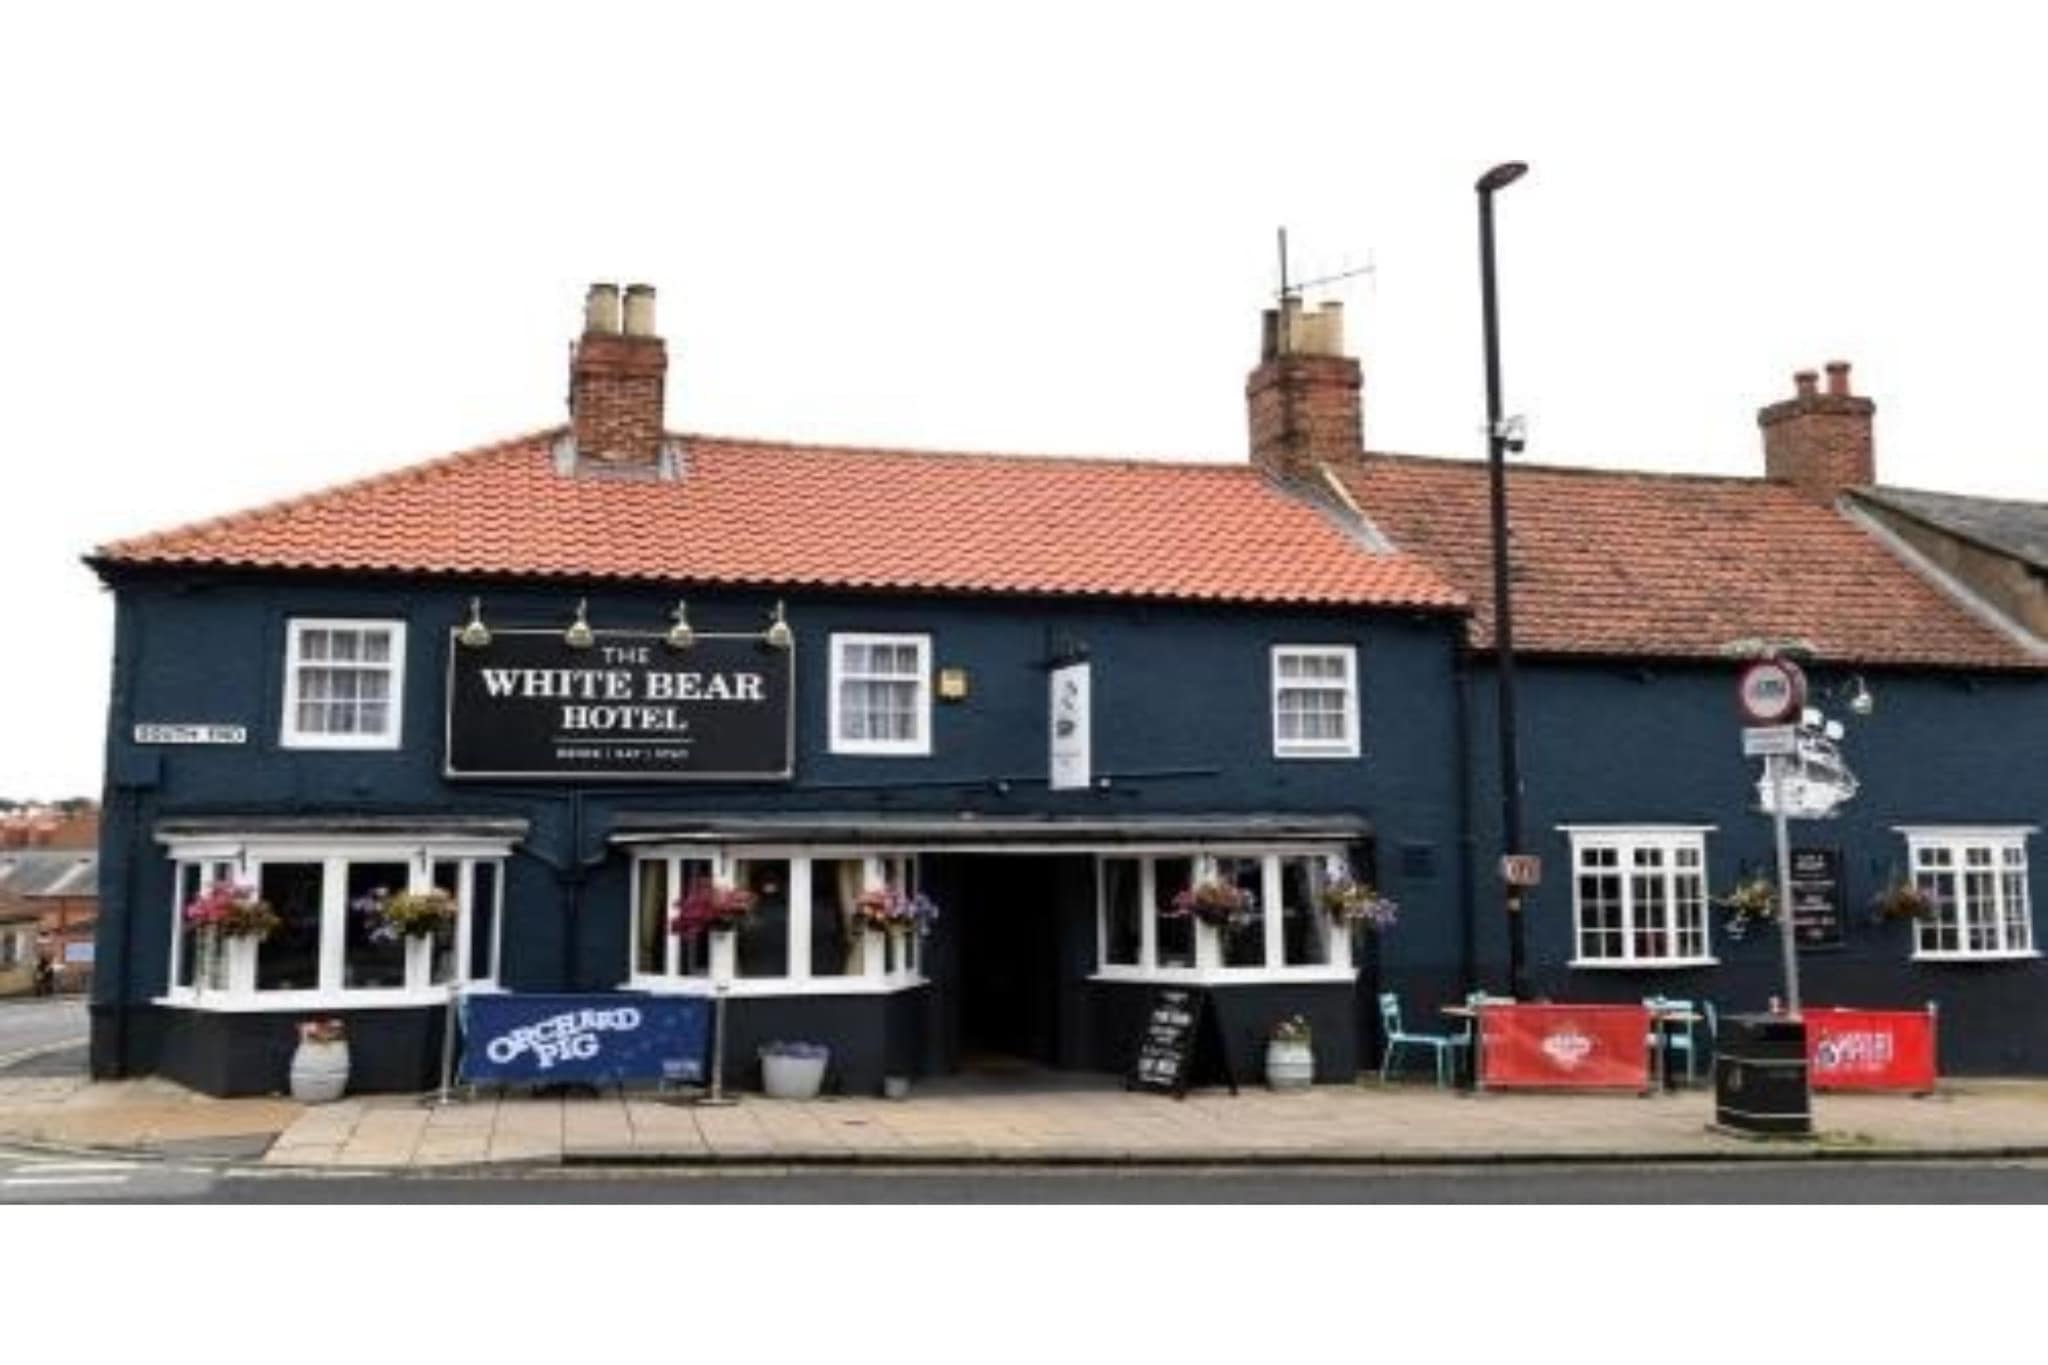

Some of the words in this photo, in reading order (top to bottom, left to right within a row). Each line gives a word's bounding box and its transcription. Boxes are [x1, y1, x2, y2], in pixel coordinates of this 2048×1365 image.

[602, 647, 650, 664] THE
[481, 669, 633, 699] WHITE
[646, 672, 766, 700] BEAR
[561, 705, 689, 730] HOTEL
[486, 1007, 641, 1064] ORCHARD
[538, 1033, 600, 1069] PIG
